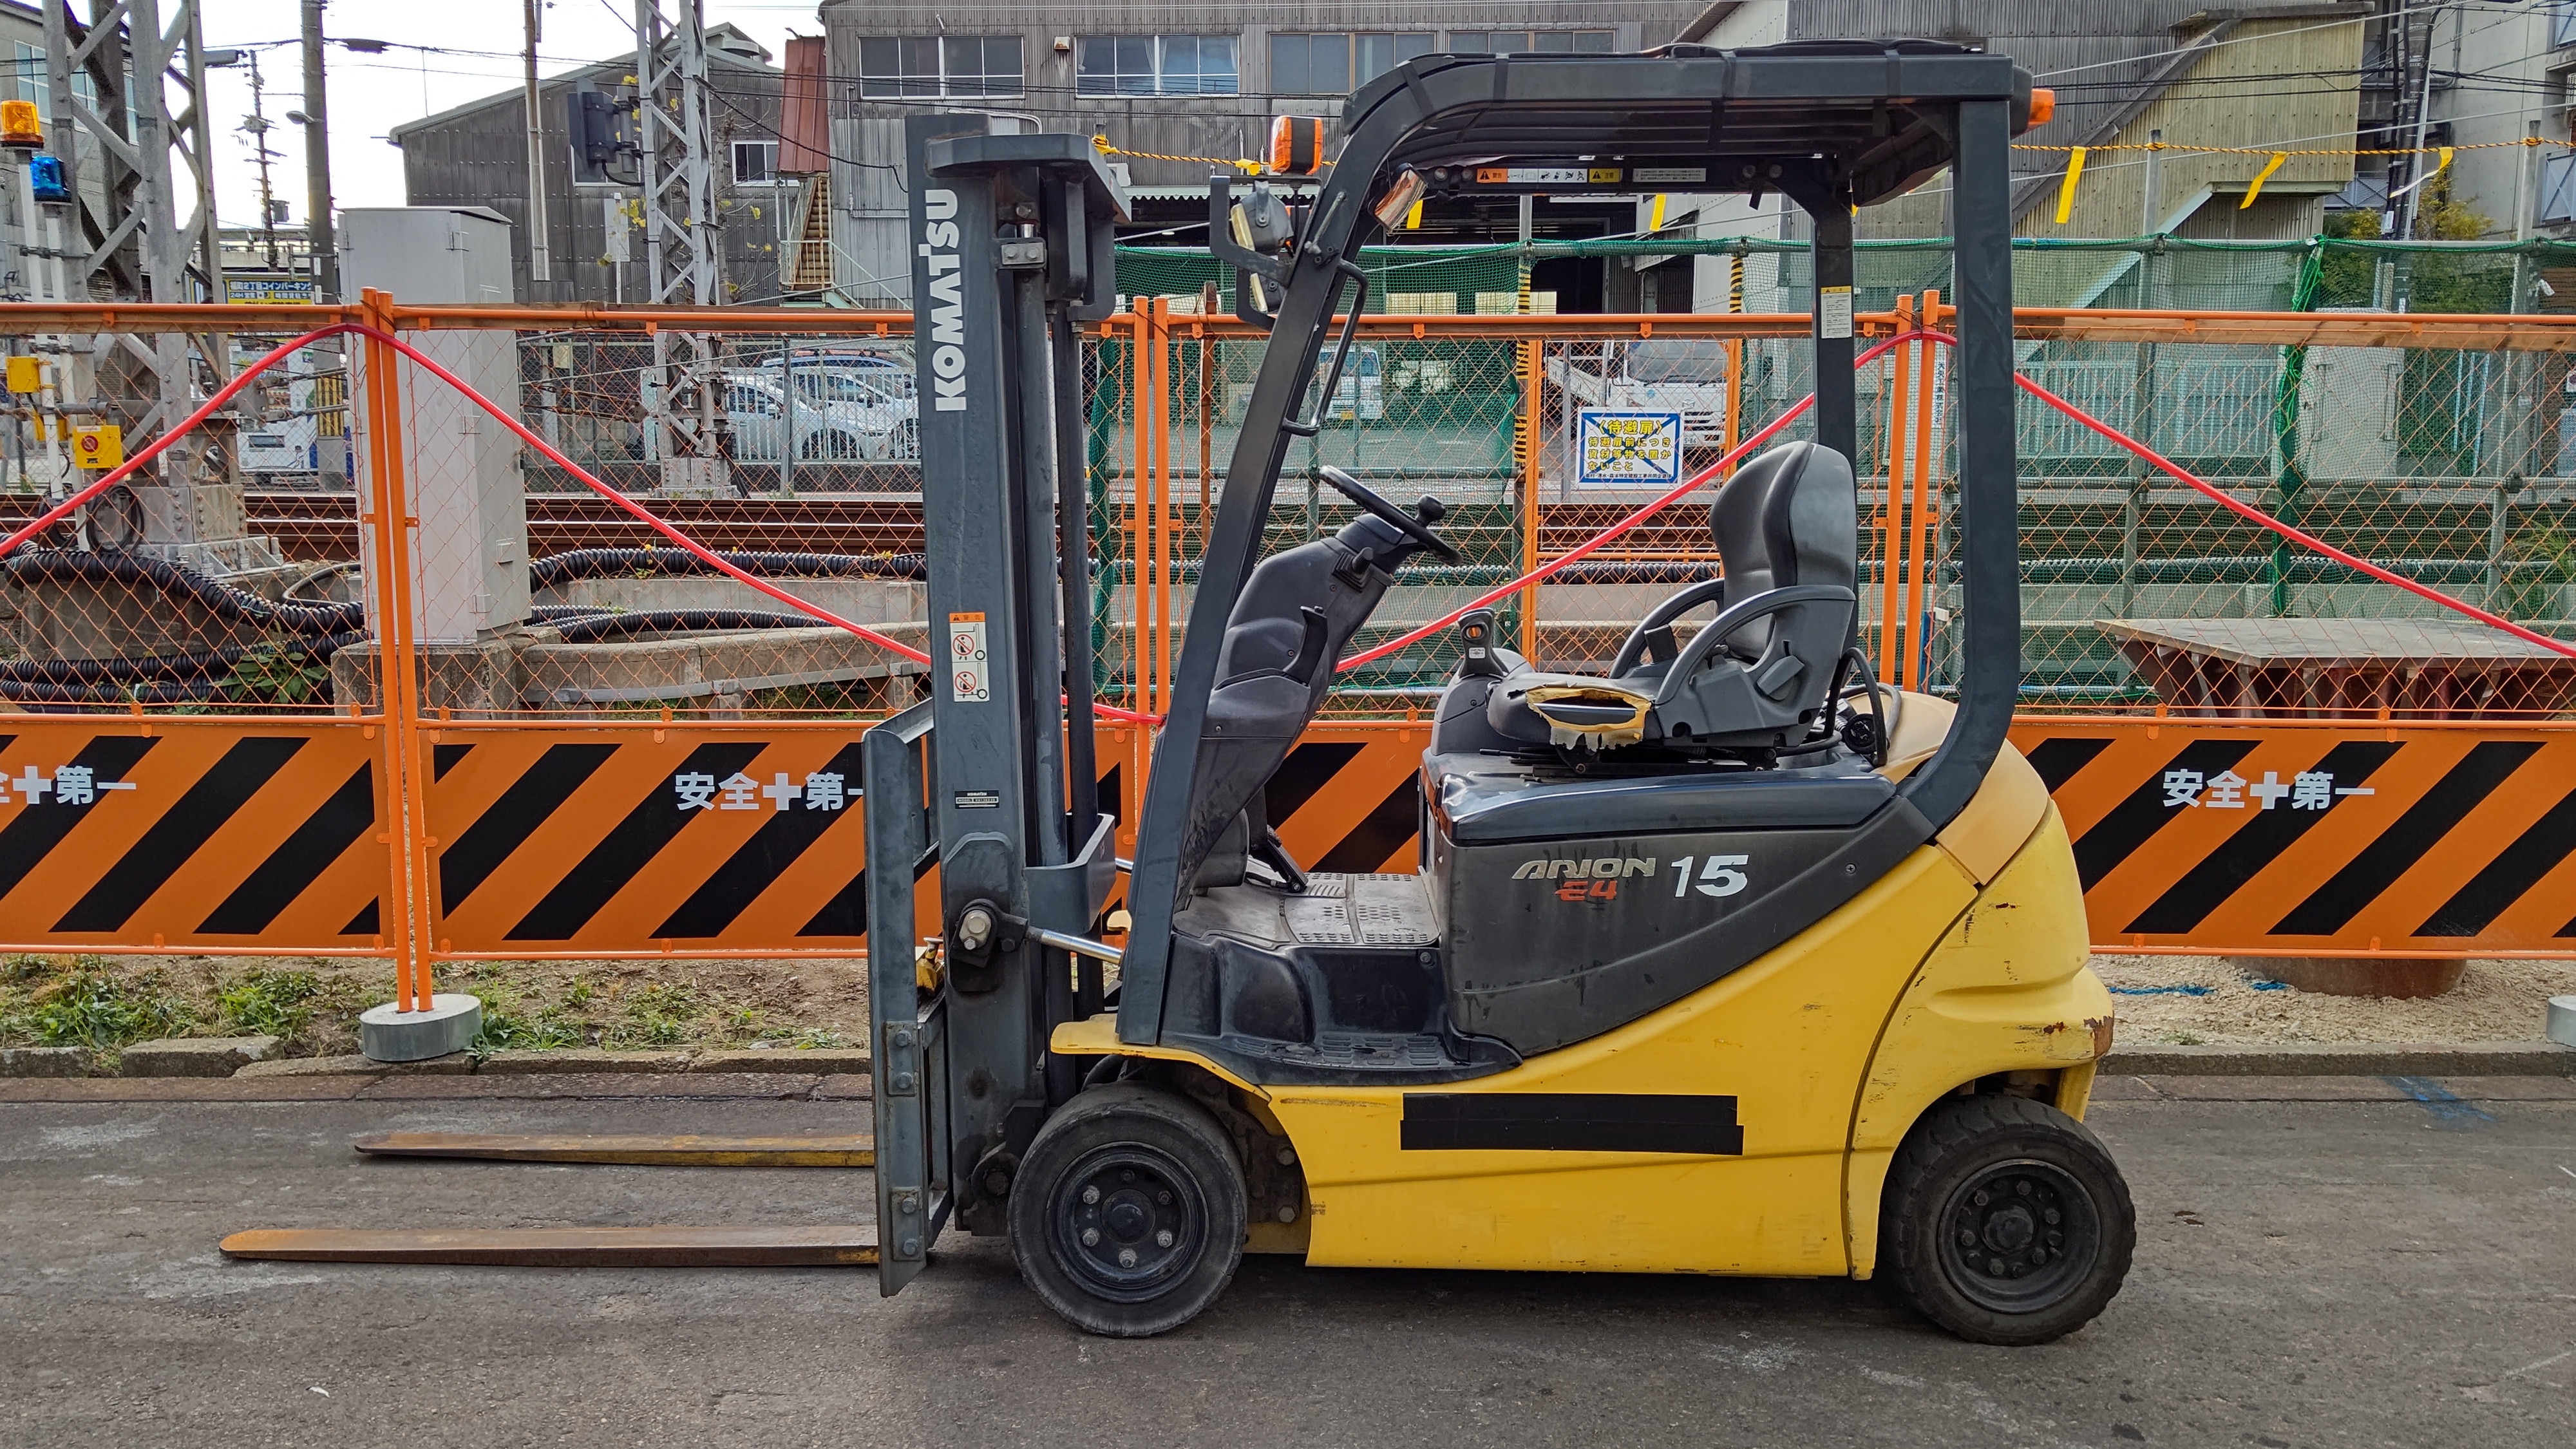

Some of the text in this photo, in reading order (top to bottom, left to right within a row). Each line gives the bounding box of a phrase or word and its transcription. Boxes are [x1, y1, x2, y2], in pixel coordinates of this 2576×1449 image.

[918, 189, 967, 411] KOMATSU
[1588, 437, 1671, 447] 待避扉前につき
[1588, 450, 1671, 460] 資材等物を置か
[1588, 462, 1633, 471] ないこと
[1511, 854, 1749, 898] ARION 15
[1555, 880, 1617, 901] E4
